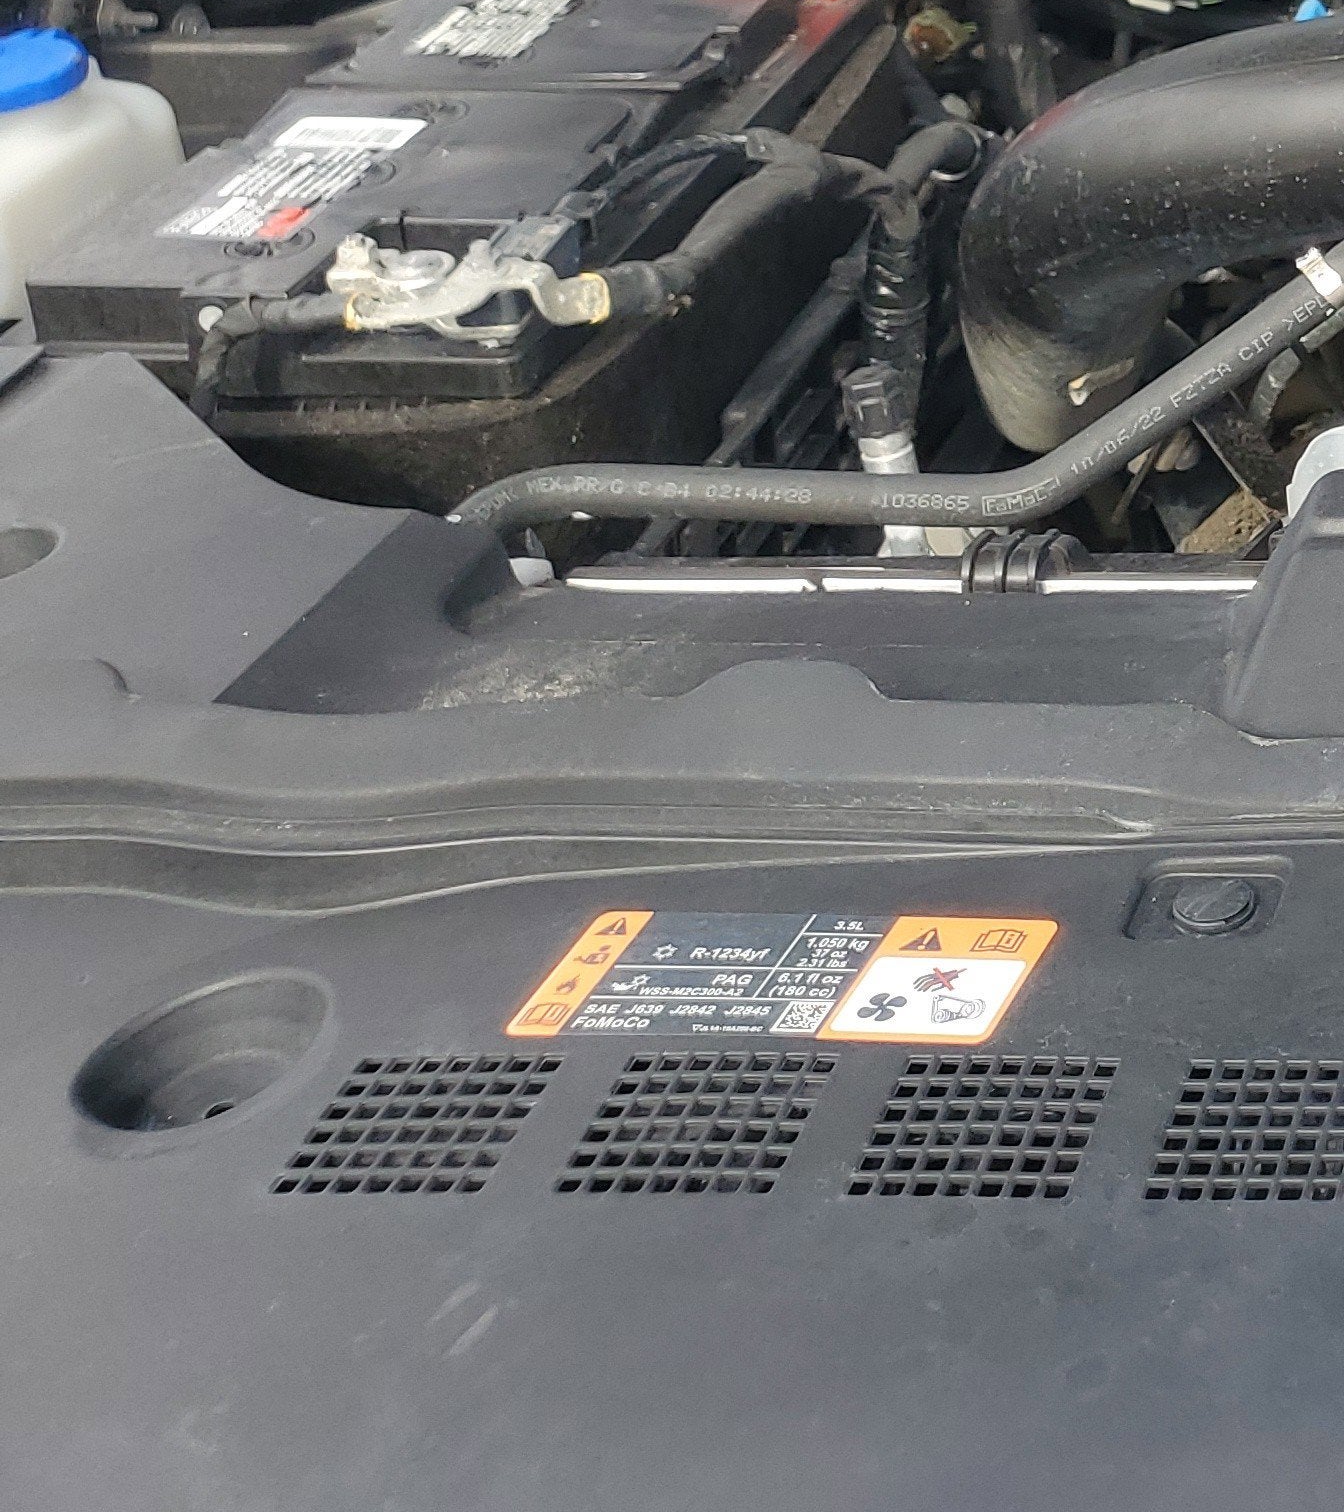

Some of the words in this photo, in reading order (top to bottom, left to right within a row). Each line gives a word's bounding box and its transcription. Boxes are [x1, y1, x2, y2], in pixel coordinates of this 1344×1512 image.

[880, 494, 970, 512] 1036865
[1238, 330, 1274, 361] CIP
[834, 921, 864, 931] 3.5L
[807, 937, 848, 948] 1.050
[848, 938, 870, 952] kg
[689, 947, 771, 962] R-1234yf
[811, 949, 831, 958] 37
[830, 950, 848, 958] oz
[796, 958, 826, 967] 2.31
[826, 959, 848, 968] lbs
[712, 974, 753, 985] PAG
[777, 972, 804, 983] 6.1
[806, 972, 820, 984] fl
[821, 975, 844, 984] oz
[768, 985, 807, 997] (180
[808, 986, 836, 999] cc)
[584, 1003, 622, 1014] SAE
[625, 1004, 664, 1014] J639
[669, 1005, 717, 1015] J2842
[723, 1006, 772, 1015] J2845
[570, 1016, 651, 1028] FoMoCo
